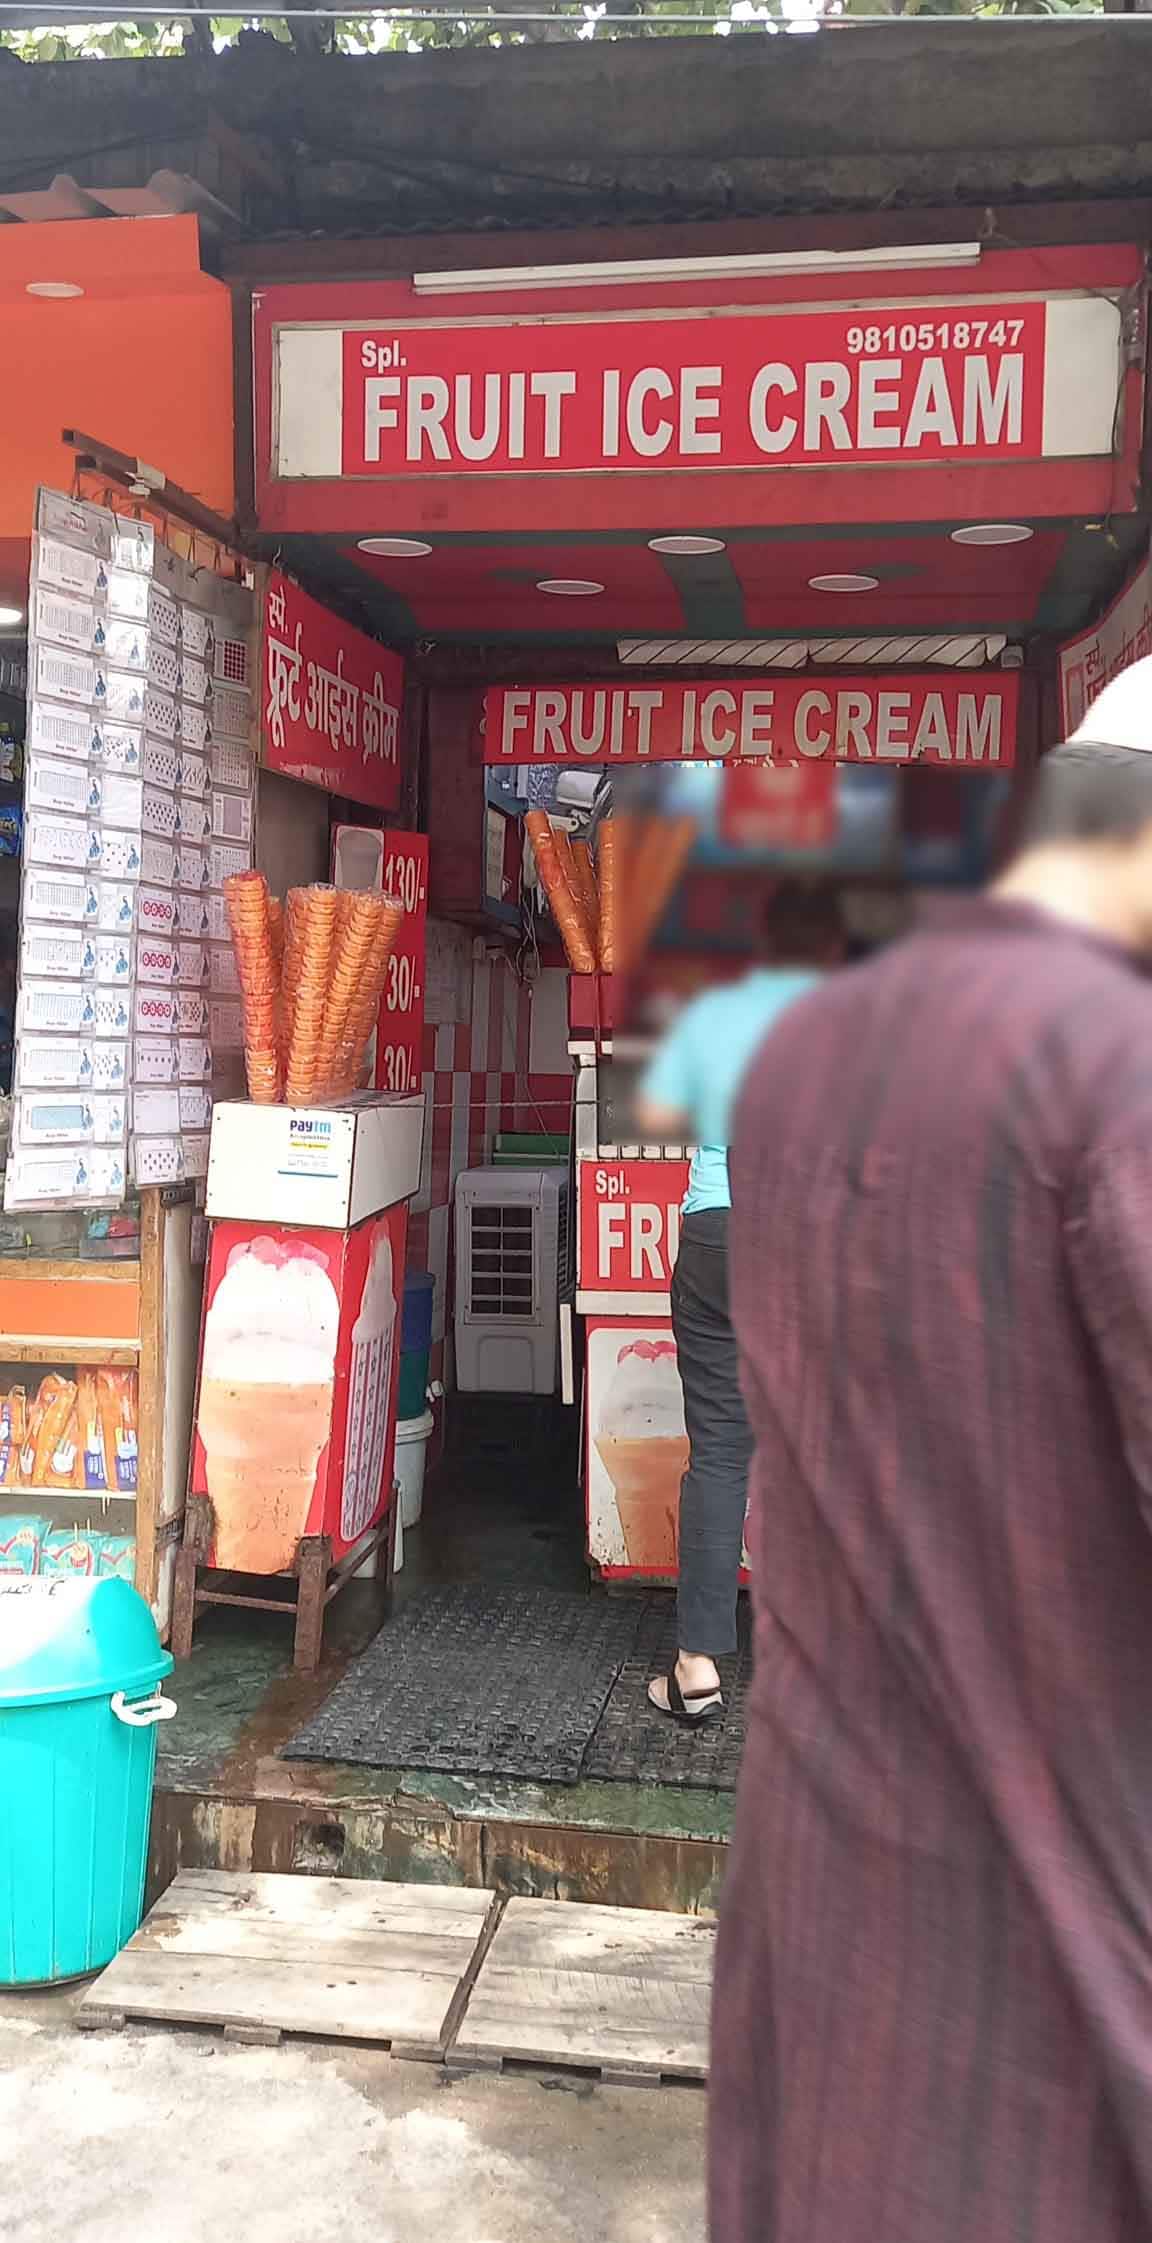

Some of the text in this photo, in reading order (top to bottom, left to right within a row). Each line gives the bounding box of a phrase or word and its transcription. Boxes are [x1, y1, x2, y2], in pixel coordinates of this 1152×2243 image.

[361, 340, 407, 373] Spl.
[846, 320, 1025, 354] 9810518747
[363, 353, 1025, 462] FRUIT ICE CREAM
[501, 689, 1003, 760] FRUIT ICE CREAM
[385, 854, 425, 913] 130/-
[595, 1170, 630, 1200] Spl.
